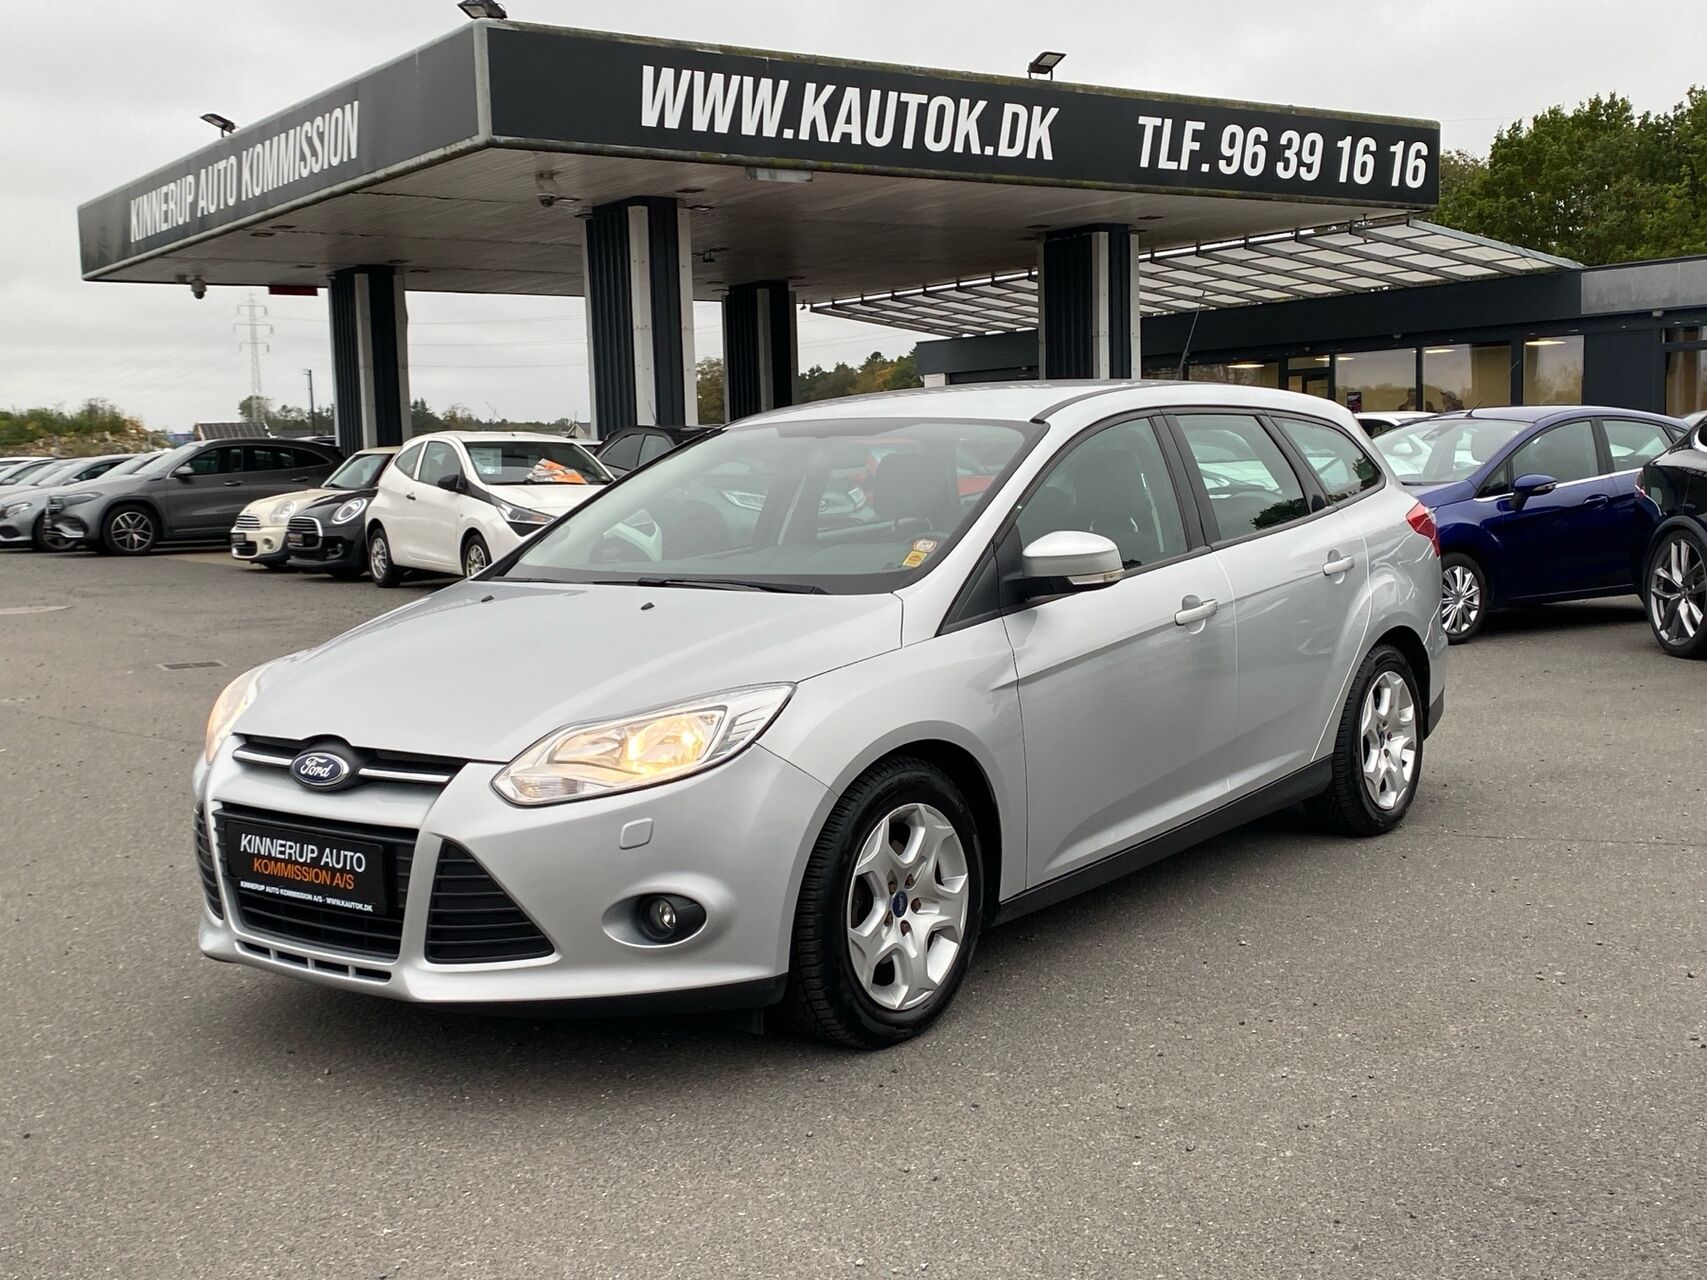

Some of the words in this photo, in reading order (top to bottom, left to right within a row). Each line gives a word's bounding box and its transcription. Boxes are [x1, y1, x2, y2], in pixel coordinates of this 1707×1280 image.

[640, 65, 1060, 161] WWW.KAUTOK.DK
[130, 174, 196, 243] KINNERUP
[197, 155, 238, 218] AUTO
[241, 100, 360, 201] KOMMISSION
[1137, 115, 1210, 173] TLF.
[1218, 123, 1269, 177] 96
[1276, 129, 1324, 181] 39
[1337, 135, 1377, 185] 16
[1389, 140, 1429, 189] 16
[299, 756, 334, 778] Ford
[240, 833, 318, 863] KINNERUP
[320, 847, 366, 873] AUTO
[253, 857, 330, 885] KOMMISSION
[333, 872, 355, 890] A/S
[265, 886, 280, 895] AUTO
